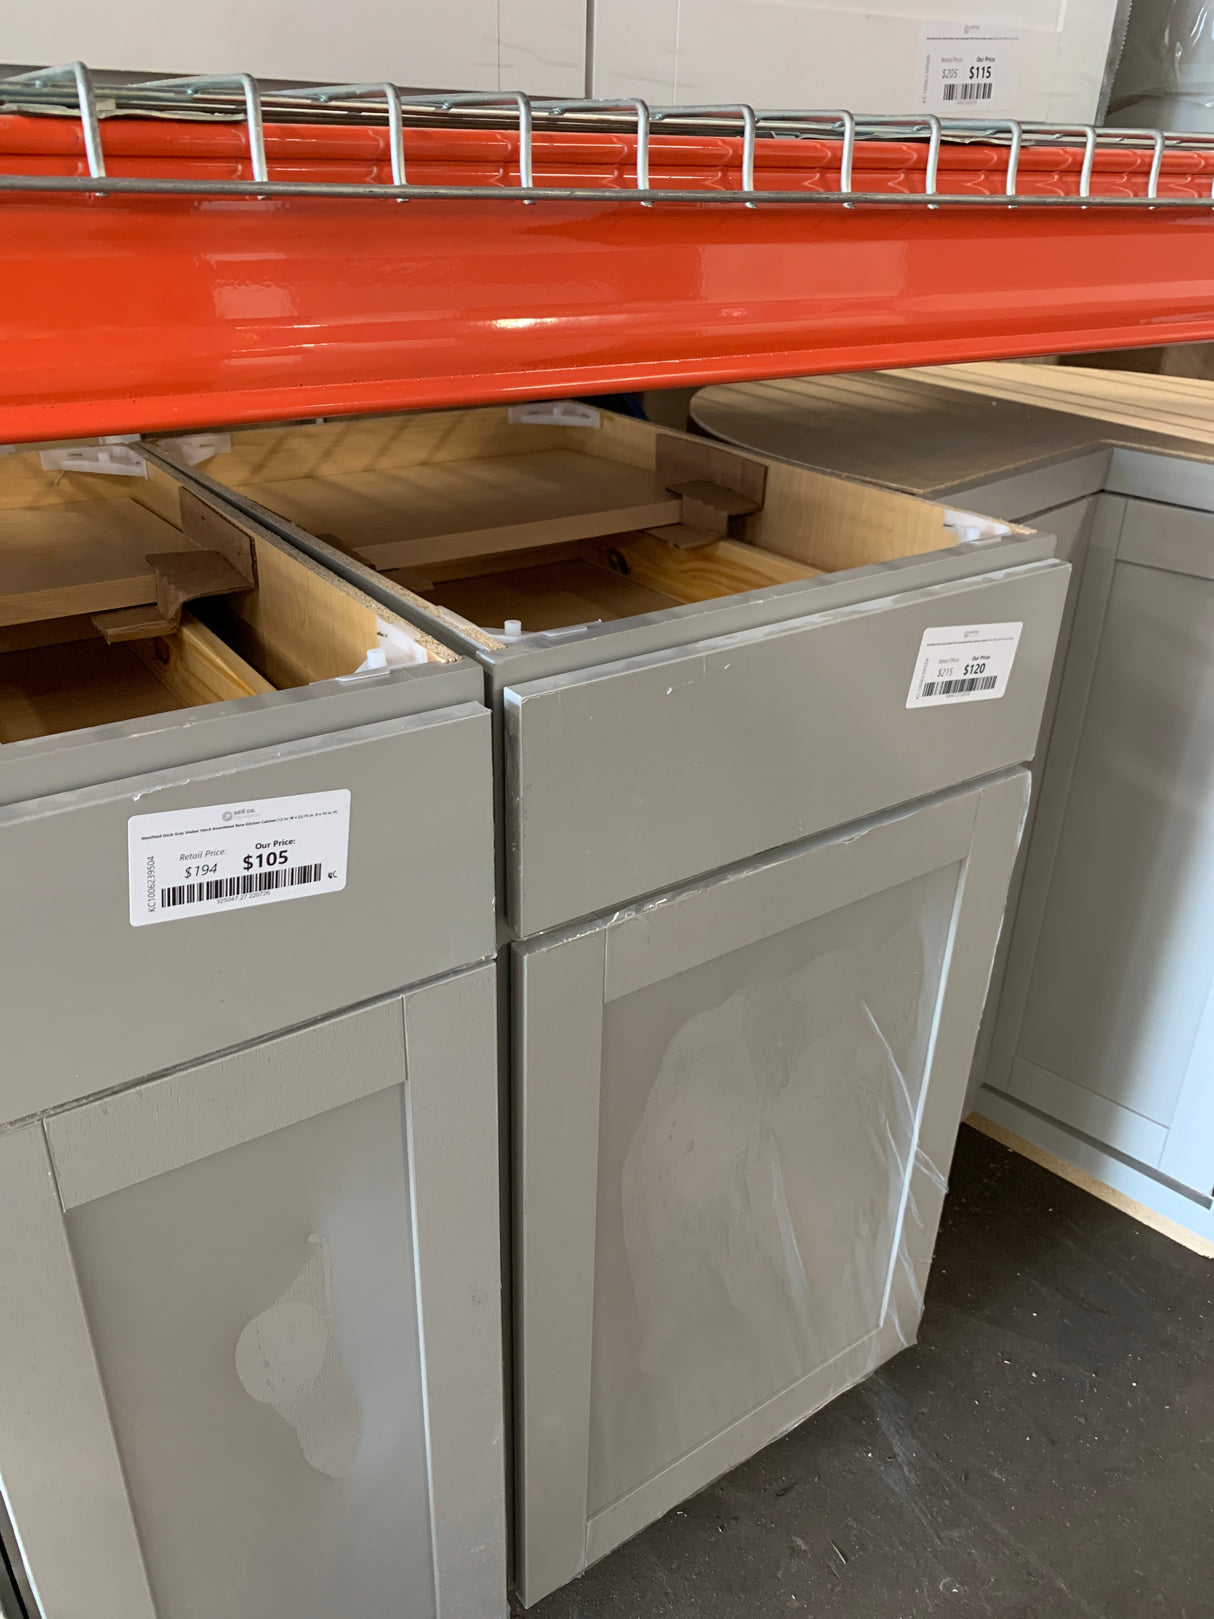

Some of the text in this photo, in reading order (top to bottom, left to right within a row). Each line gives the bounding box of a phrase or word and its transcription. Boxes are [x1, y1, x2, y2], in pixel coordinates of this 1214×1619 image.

[942, 68, 958, 79] $205
[968, 66, 992, 80] $115
[936, 667, 954, 678] $215
[963, 662, 986, 676] $120
[273, 839, 296, 847] Price:
[179, 849, 227, 861] Retail Price:
[243, 850, 288, 871] $105
[184, 863, 218, 879] $194
[147, 856, 156, 912] KC1006239504
